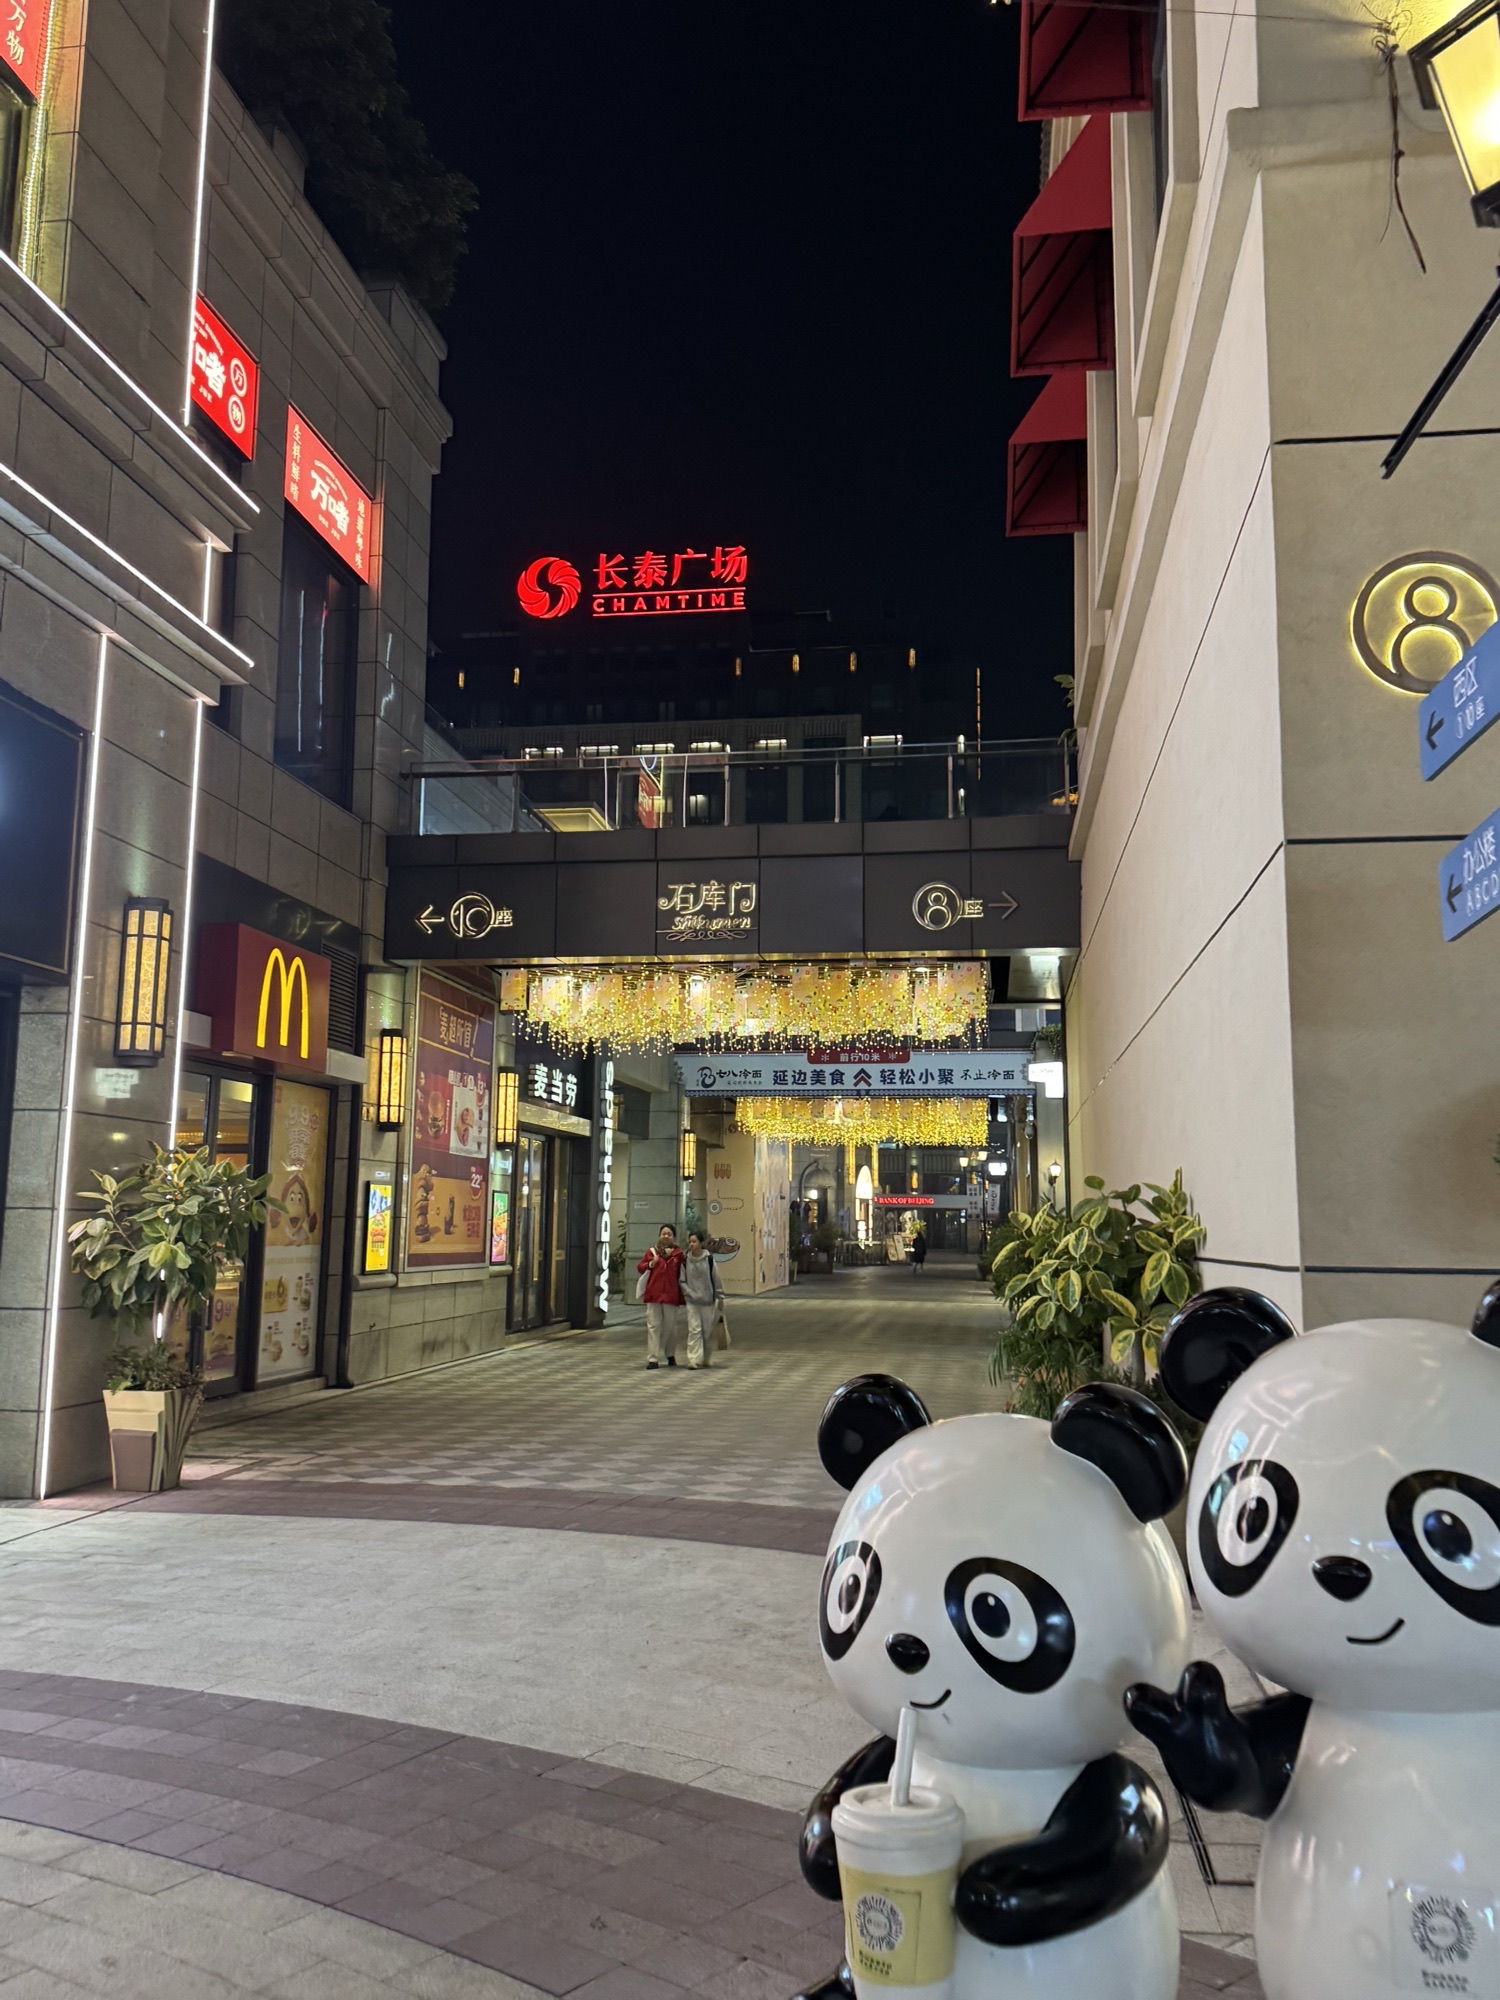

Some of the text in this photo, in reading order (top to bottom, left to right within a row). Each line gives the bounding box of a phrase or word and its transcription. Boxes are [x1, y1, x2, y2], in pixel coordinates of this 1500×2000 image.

[593, 545, 748, 590] 长泰广场
[593, 591, 745, 612] CHAMTIME
[1453, 655, 1479, 708] 西区
[1462, 825, 1497, 885] 办公楼
[657, 879, 756, 916] 石库门
[839, 1053, 881, 1062] 前行10米
[533, 1062, 578, 1107] 麦当劳
[716, 1068, 762, 1079] 七八冷面
[772, 1069, 845, 1086] 延边美食
[879, 1068, 955, 1086] 轻松小聚
[960, 1069, 1015, 1081] 不止冷面
[879, 1197, 898, 1205] BANK
[907, 1197, 934, 1205] BEIJING
